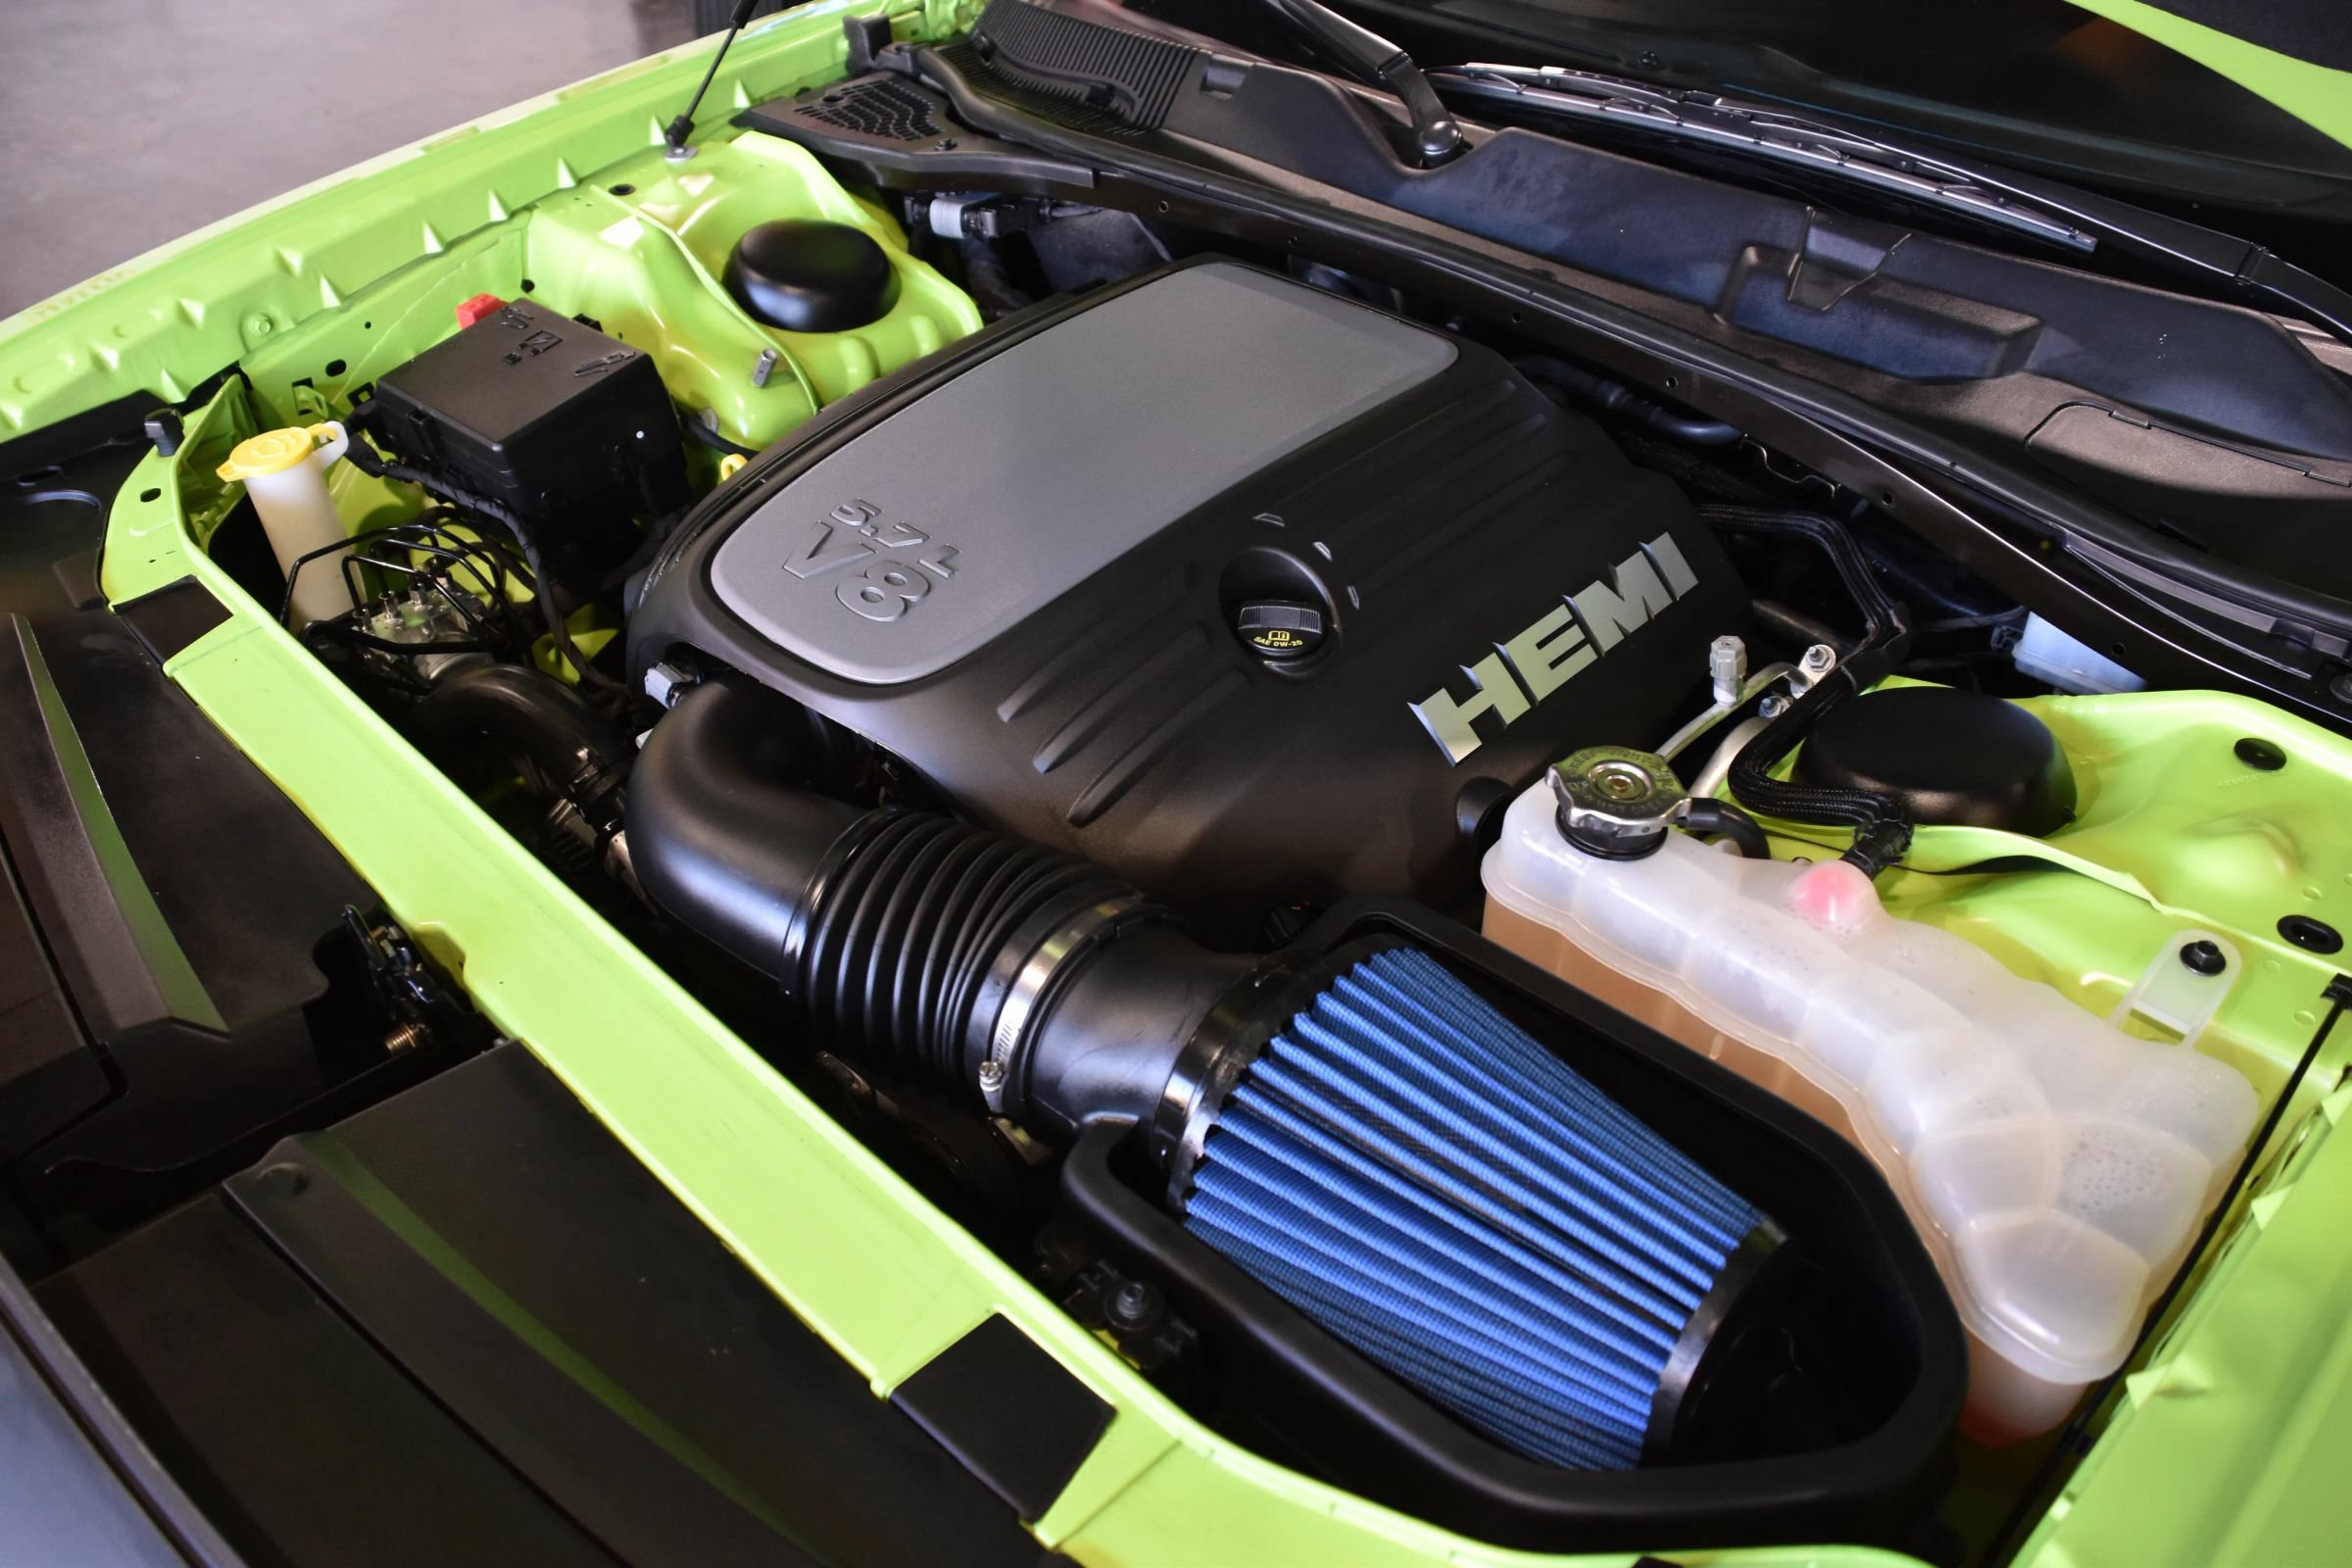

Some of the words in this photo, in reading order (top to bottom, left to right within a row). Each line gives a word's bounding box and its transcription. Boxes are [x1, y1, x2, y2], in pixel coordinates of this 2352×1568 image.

[782, 520, 932, 622] V8
[1254, 636, 1271, 647] SAE
[1406, 531, 1699, 767] HEMI
